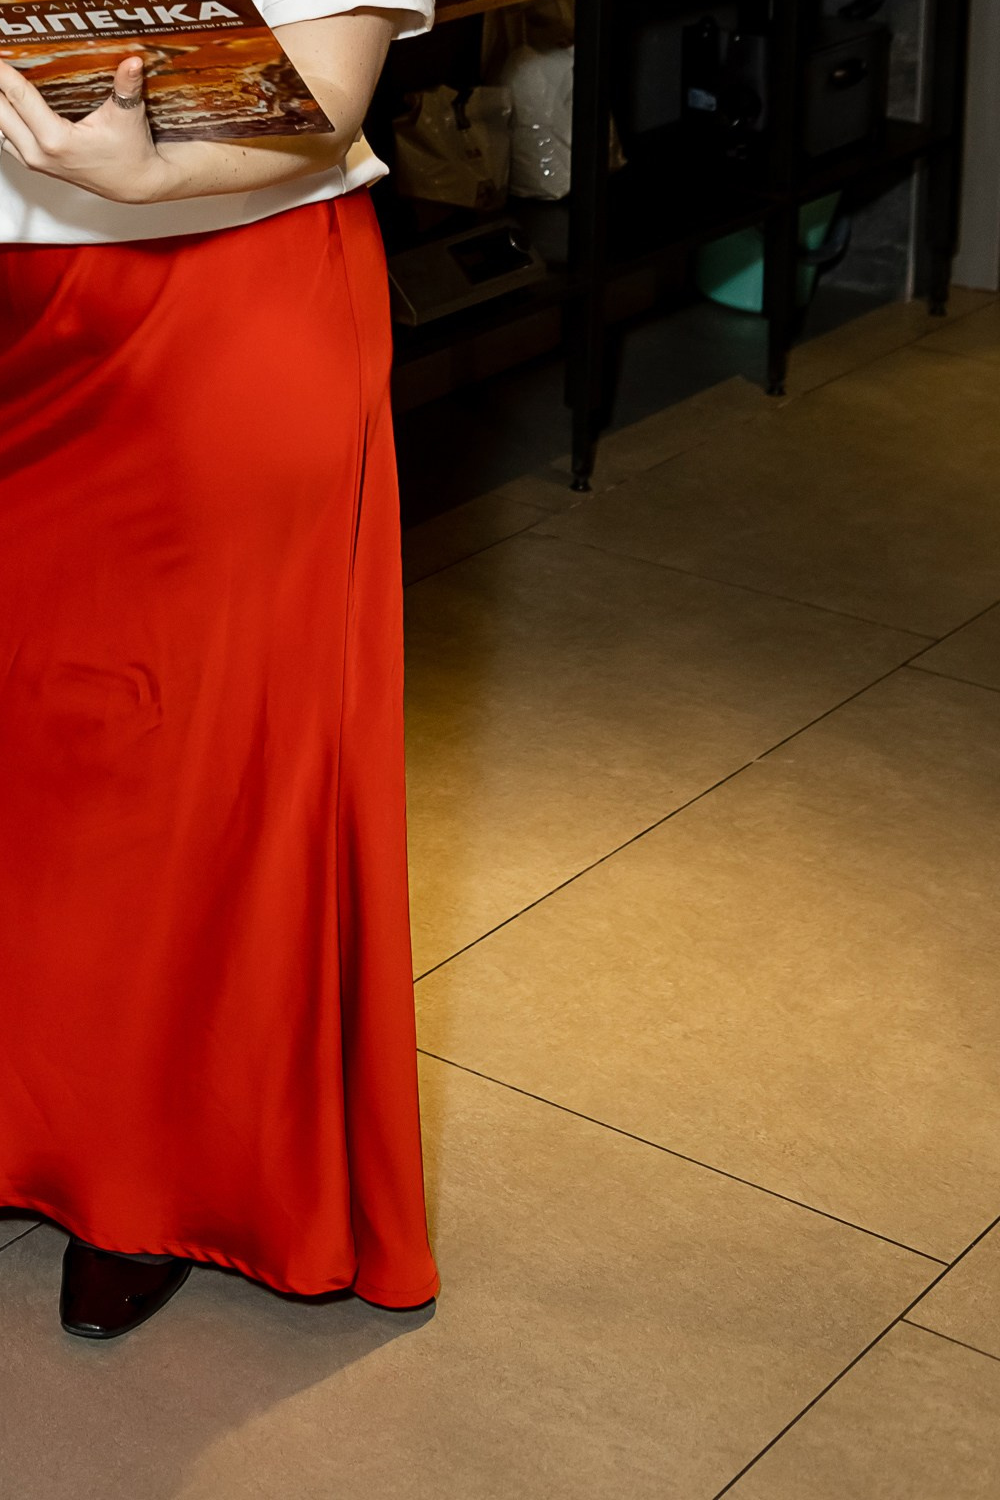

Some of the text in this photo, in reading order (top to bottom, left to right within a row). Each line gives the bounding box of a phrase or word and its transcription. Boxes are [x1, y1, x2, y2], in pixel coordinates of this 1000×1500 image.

[46, 33, 95, 41] ПИРОЖНЫЕ
[100, 29, 138, 37] ПЕЧЕНЬЕ
[180, 23, 215, 31] РУЛЕТЫ
